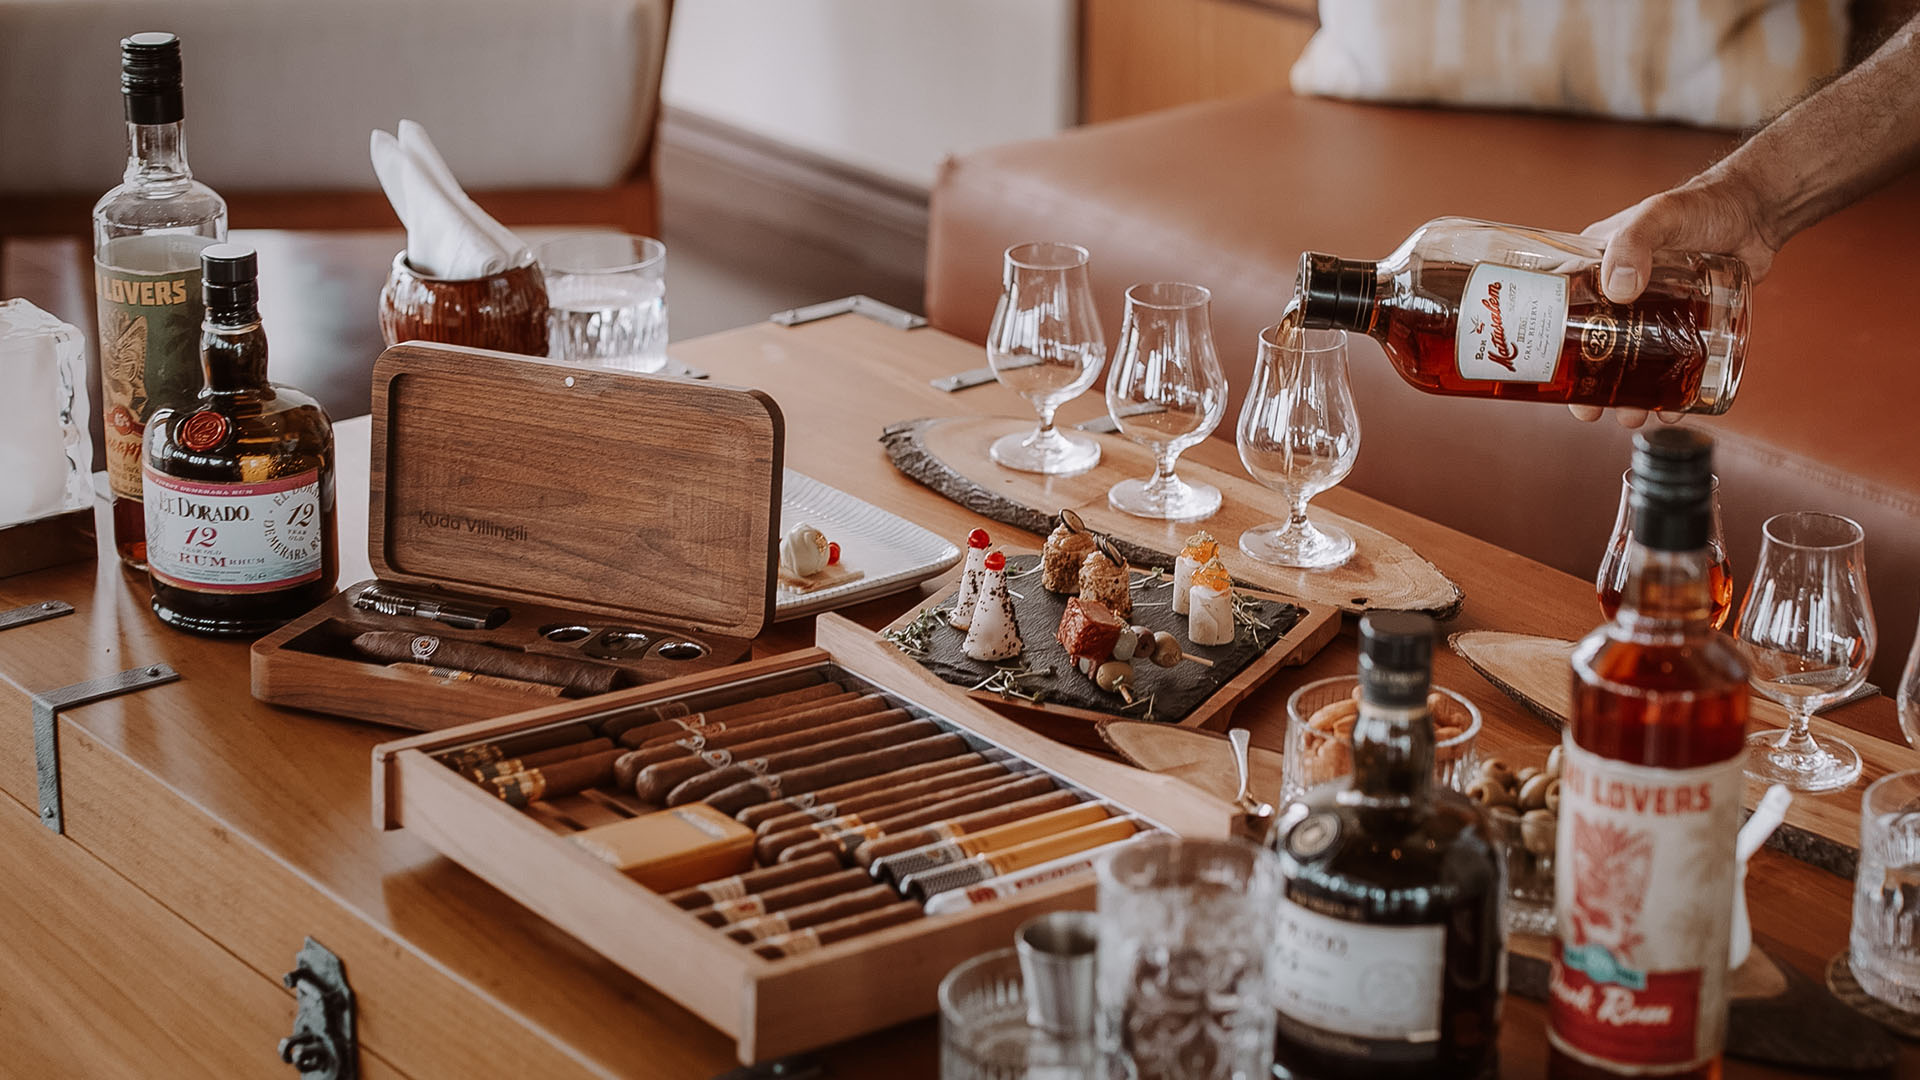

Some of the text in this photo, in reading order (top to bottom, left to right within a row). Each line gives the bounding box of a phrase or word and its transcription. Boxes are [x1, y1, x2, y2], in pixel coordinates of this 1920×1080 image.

[103, 276, 187, 305] LOVERS
[1481, 281, 1517, 373] Matusalem
[1590, 329, 1608, 350] 23
[178, 496, 250, 525] DORADO
[286, 502, 316, 528] 12
[419, 509, 529, 541] Kuda Villingili
[184, 526, 218, 549] 12
[179, 552, 227, 568] RUM
[1591, 775, 1714, 817] LOVERS
